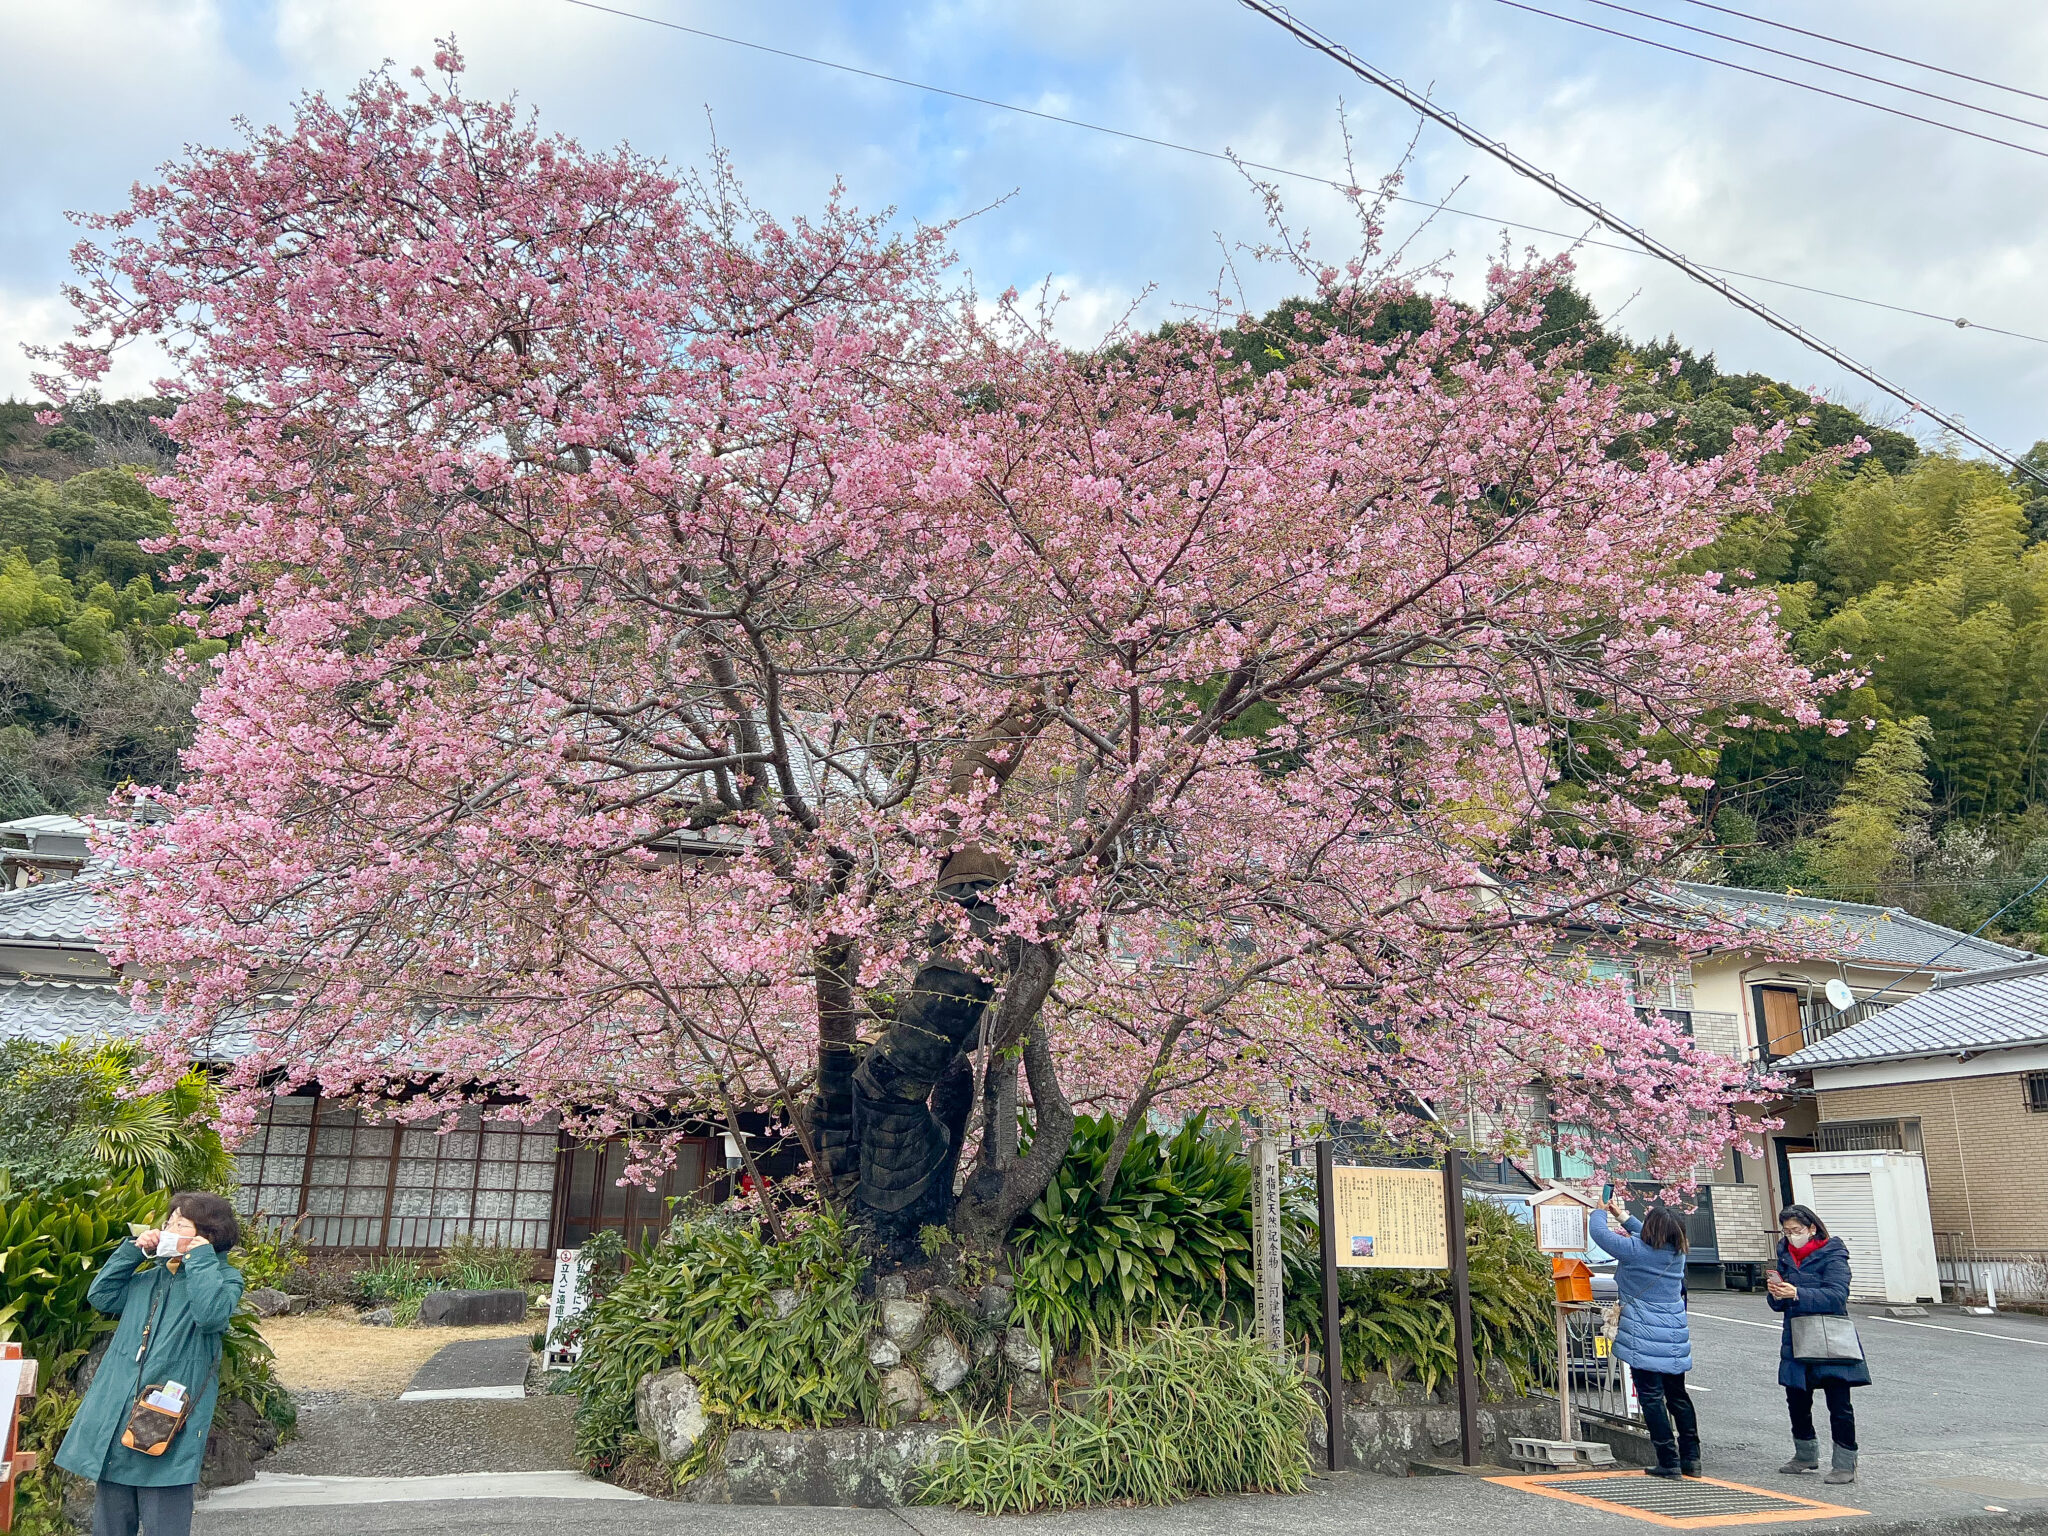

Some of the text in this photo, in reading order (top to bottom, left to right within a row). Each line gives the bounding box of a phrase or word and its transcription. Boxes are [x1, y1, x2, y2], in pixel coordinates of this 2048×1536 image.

[1253, 1164, 1261, 1208] 指定日
[1265, 1164, 1278, 1268] 町指定天然記念物
